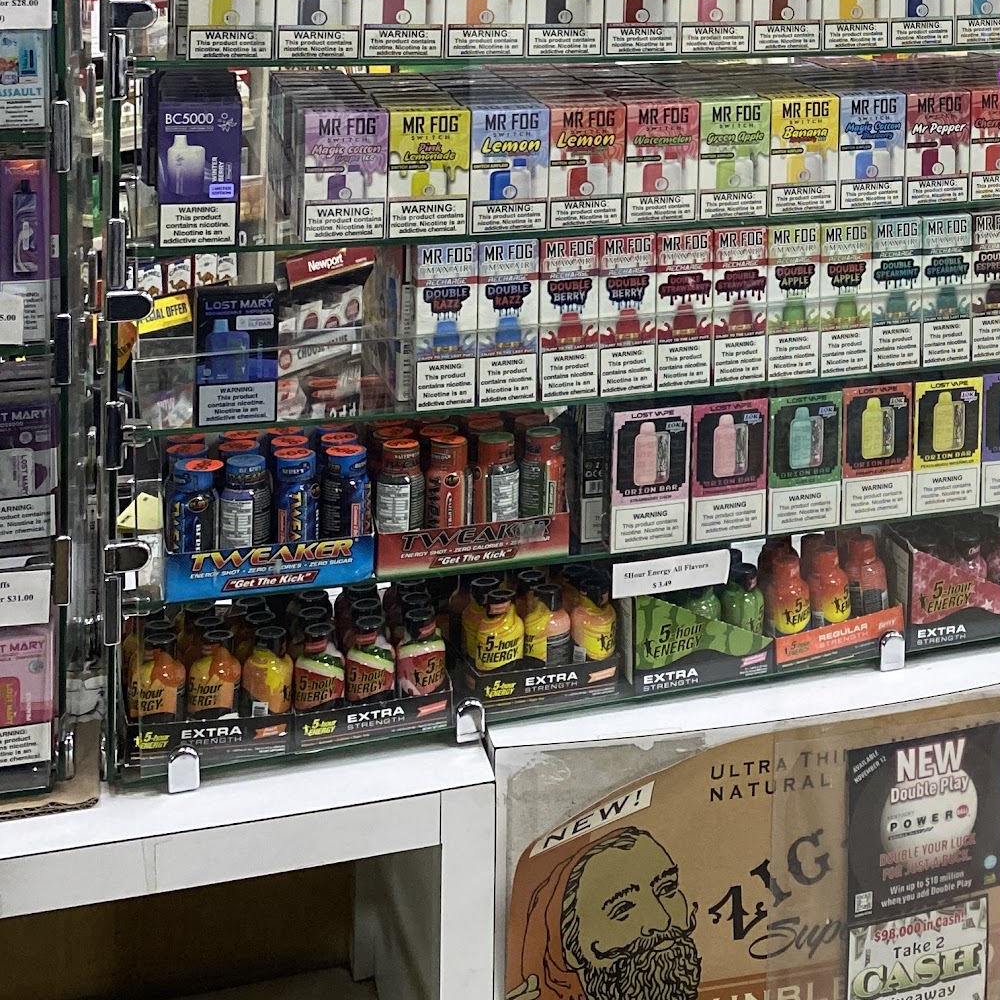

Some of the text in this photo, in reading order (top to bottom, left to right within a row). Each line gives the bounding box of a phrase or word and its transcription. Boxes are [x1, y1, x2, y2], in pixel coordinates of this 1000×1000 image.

[205, 32, 258, 40] WARNING:
[165, 113, 214, 125] BC5000
[912, 122, 966, 135] Mr Pepper
[307, 254, 343, 273] Newport
[423, 246, 473, 265] MR FOG
[425, 287, 471, 300] DOUBLE
[205, 299, 274, 311] LOST MARY
[432, 300, 462, 312] RAZZ
[625, 484, 678, 496] ORION BAR
[191, 540, 354, 571] TWEAKER
[648, 568, 671, 577] Energy
[684, 562, 709, 571] Flavors
[230, 572, 311, 590] "Get The Kick"
[658, 580, 672, 588] 3.49
[486, 636, 520, 651] 5-hour
[482, 647, 518, 663] ENERGY
[644, 667, 698, 684] EXTRA
[644, 678, 699, 691] STRENGTH
[711, 758, 787, 780] ULTRA
[852, 750, 880, 774] AVAILABLE
[896, 737, 966, 783] NEW
[854, 756, 887, 784] NOVEMBER 12
[710, 774, 832, 802] NATURAL
[890, 775, 970, 804] Double Play
[543, 789, 642, 850] NEW!
[890, 810, 953, 832] POWER
[880, 833, 976, 867] DOUBLE YOUR LUCK
[890, 870, 964, 896] Win up to $10 million
[881, 879, 972, 909] when you add Double Play
[923, 919, 934, 932] in
[936, 911, 965, 930] Cash!
[893, 937, 945, 959] Take 2
[852, 942, 982, 1000] CASH
